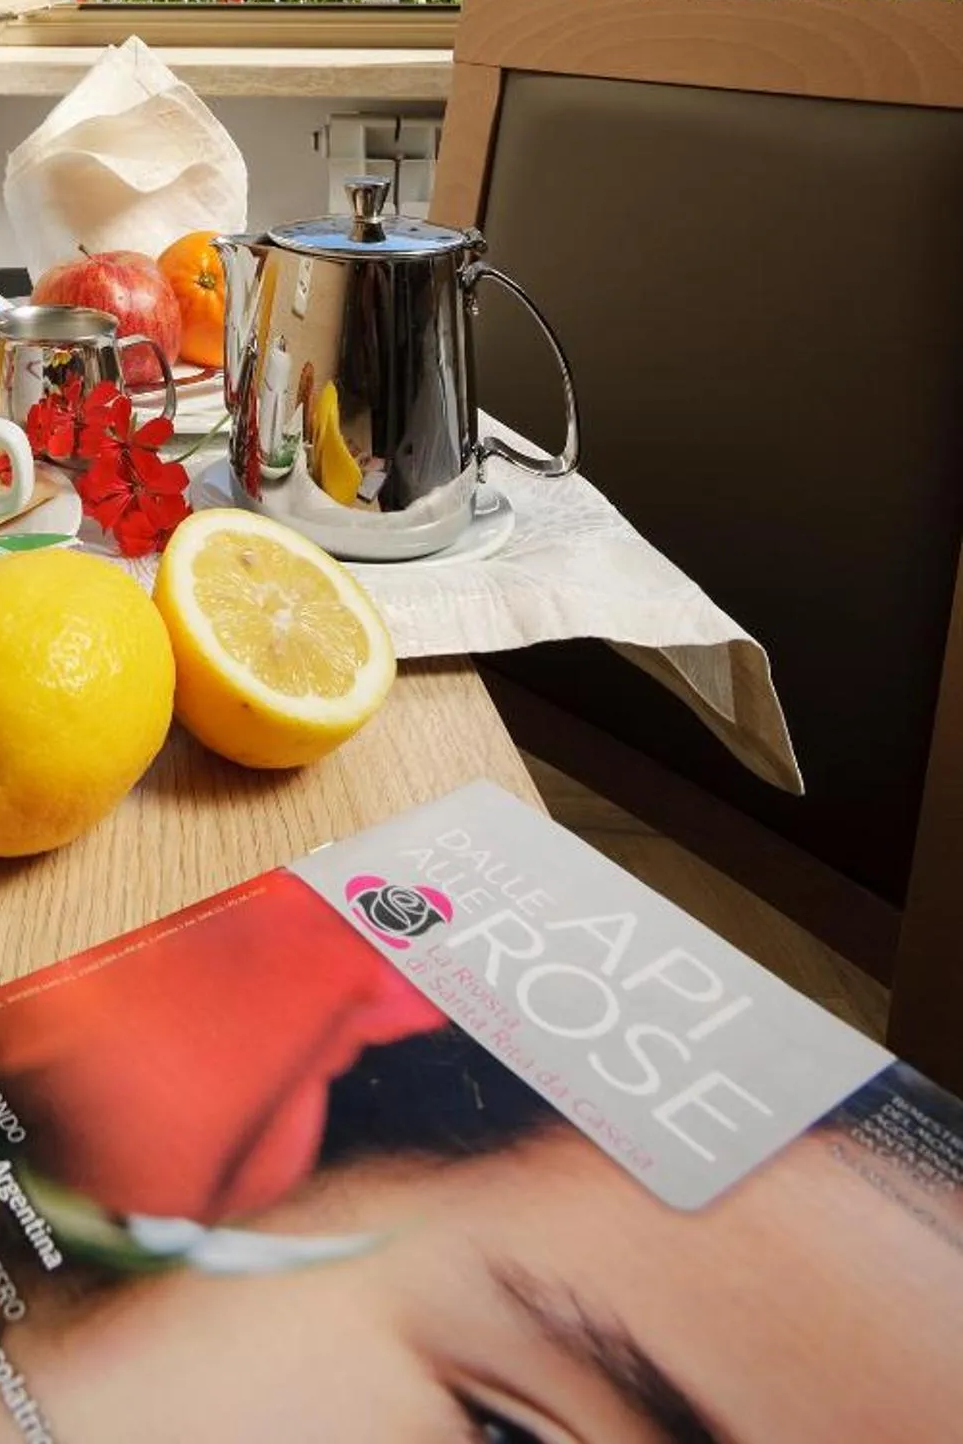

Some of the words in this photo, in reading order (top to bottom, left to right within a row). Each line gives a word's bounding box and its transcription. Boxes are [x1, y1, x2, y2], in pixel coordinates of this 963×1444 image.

[399, 848, 498, 915] ALLE
[435, 828, 554, 917] DALLE
[544, 910, 754, 1042] API
[429, 977, 488, 1032] Santa
[492, 1030, 538, 1070] Rita
[539, 1069, 569, 1100] da
[573, 1098, 655, 1171] Cascia
[444, 909, 774, 1162] ROSE
[454, 967, 522, 1032] Rivista
